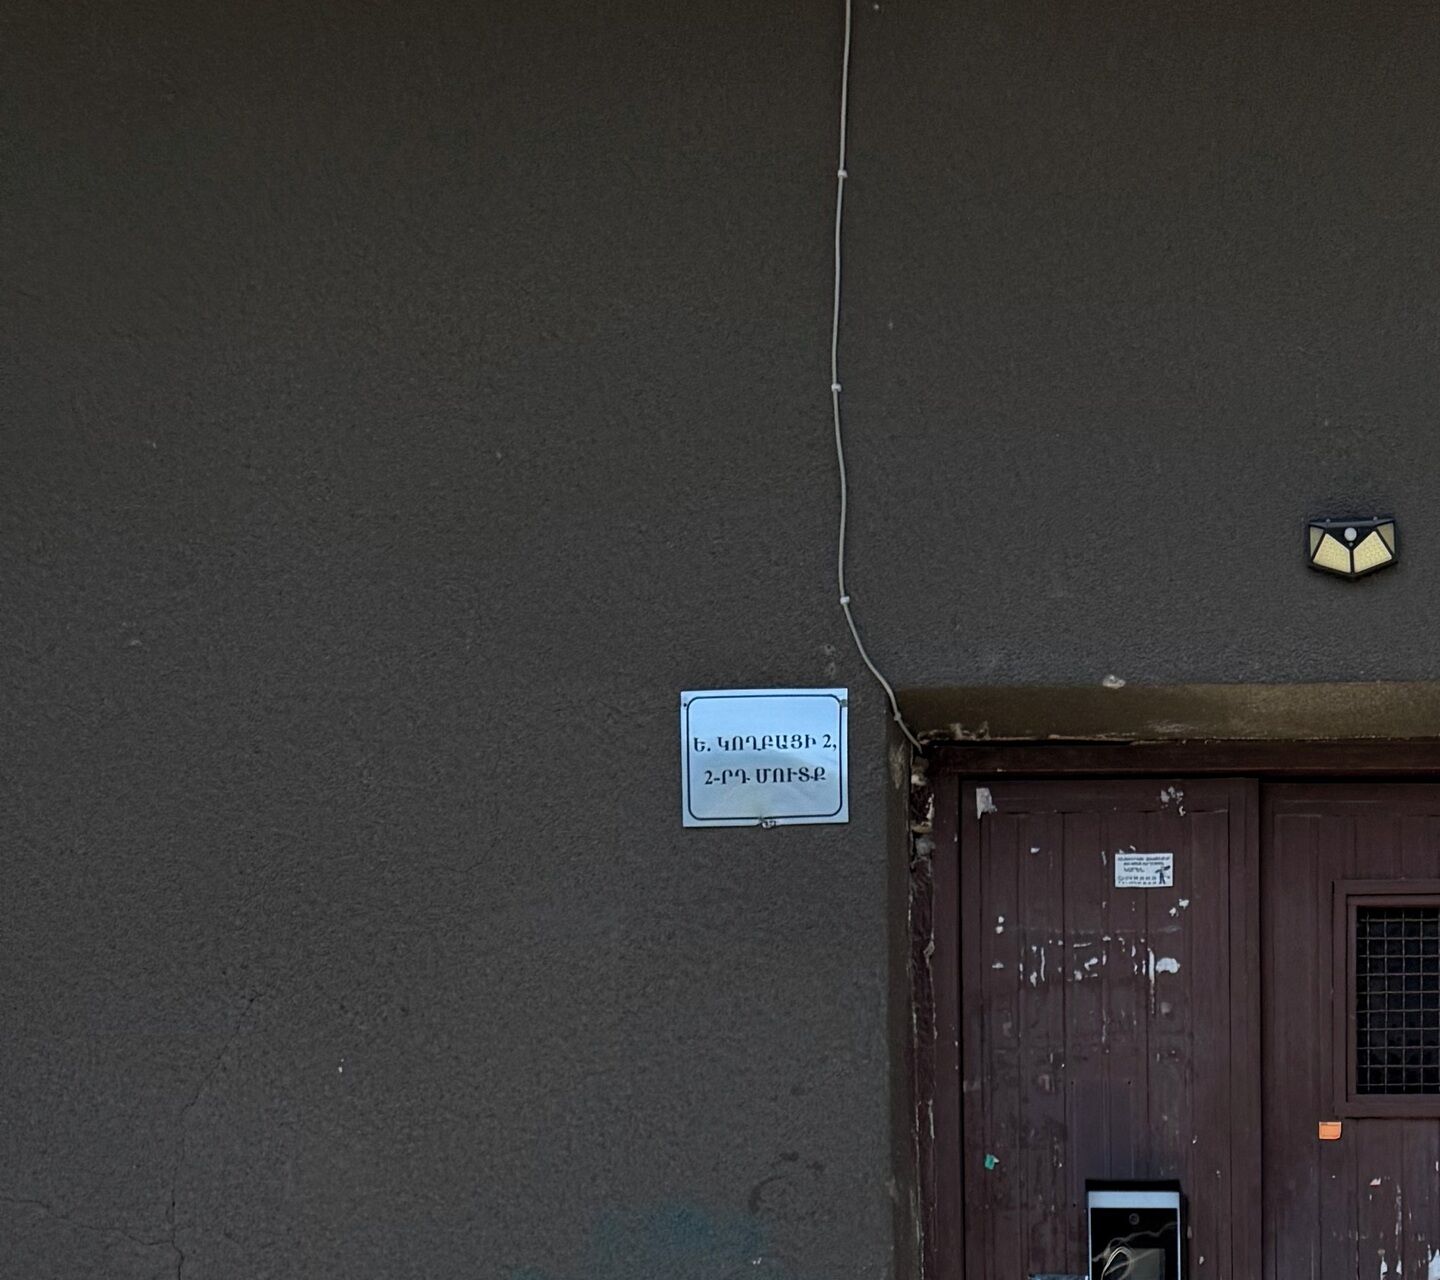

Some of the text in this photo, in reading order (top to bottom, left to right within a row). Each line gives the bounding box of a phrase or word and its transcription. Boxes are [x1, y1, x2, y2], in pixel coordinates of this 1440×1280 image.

[693, 734, 837, 752] Ե. ԿՈՂԲԱՑԻ 2,
[704, 766, 827, 786] 2-ՐԴ ՄՈՒՏՔ
